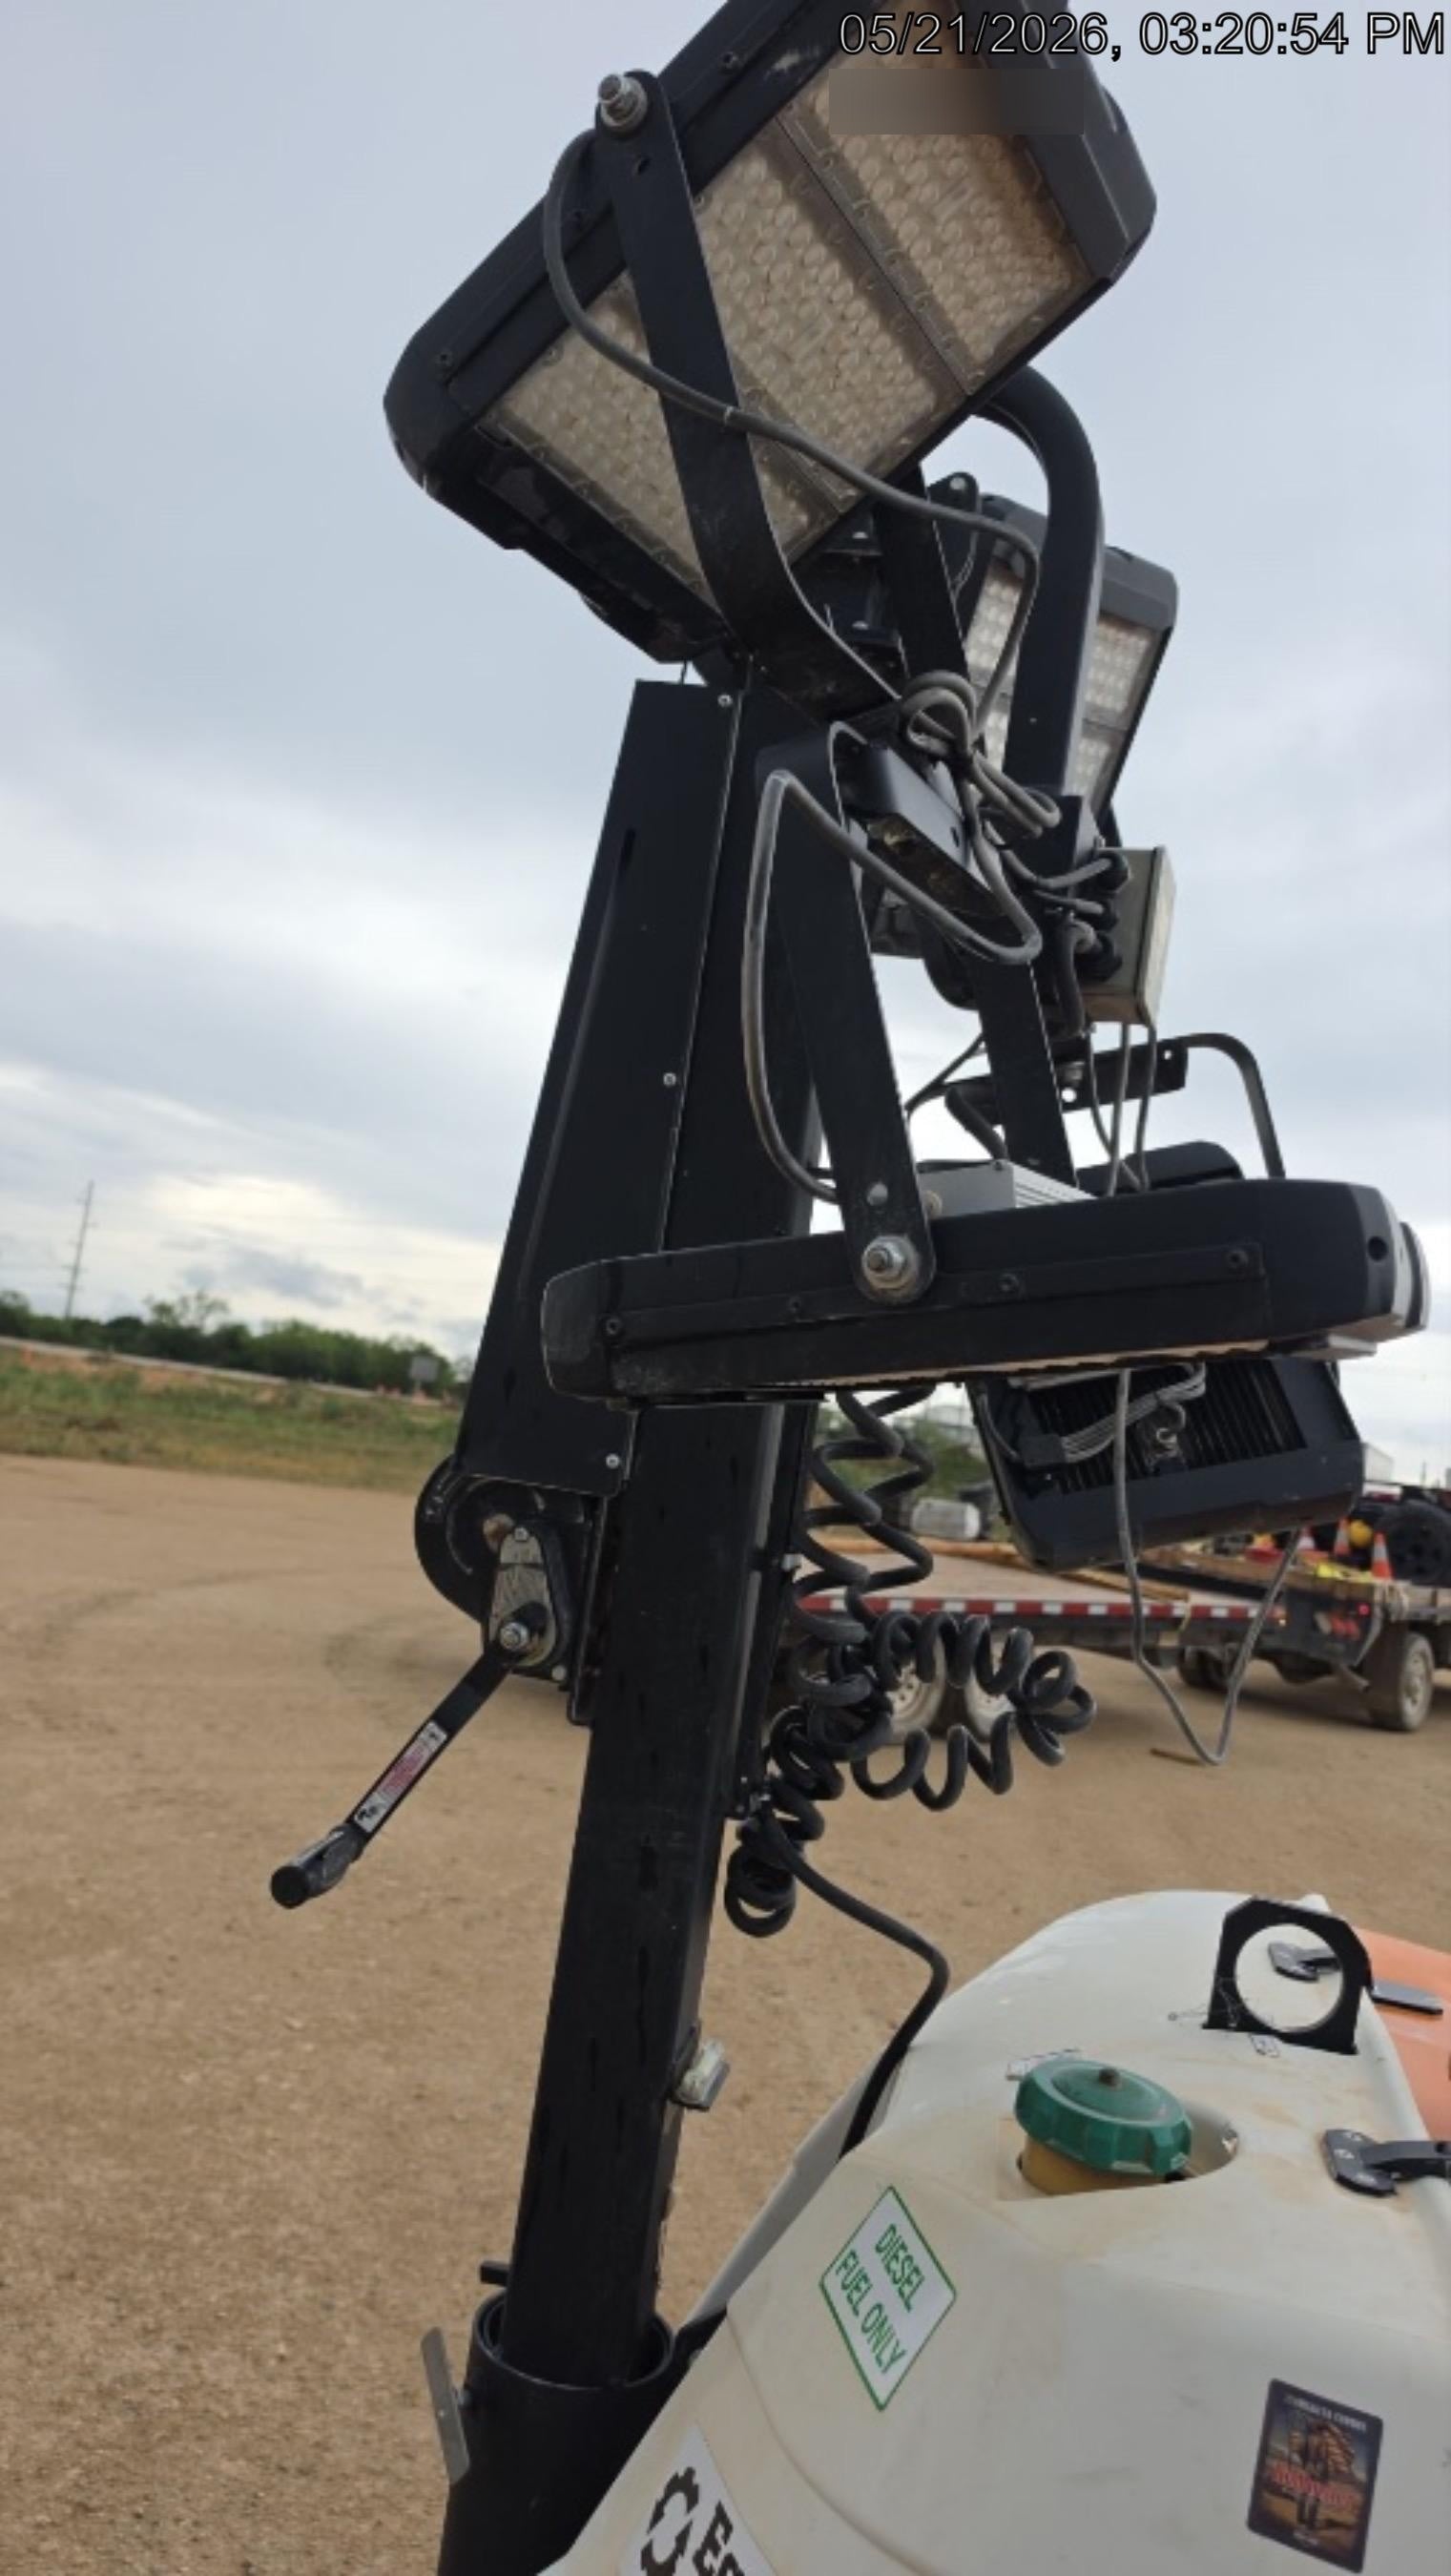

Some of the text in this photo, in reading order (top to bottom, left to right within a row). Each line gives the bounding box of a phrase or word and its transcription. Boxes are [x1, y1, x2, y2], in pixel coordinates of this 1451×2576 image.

[835, 2249, 906, 2374] FUEL ONLY
[875, 2223, 924, 2313] DIESEL
